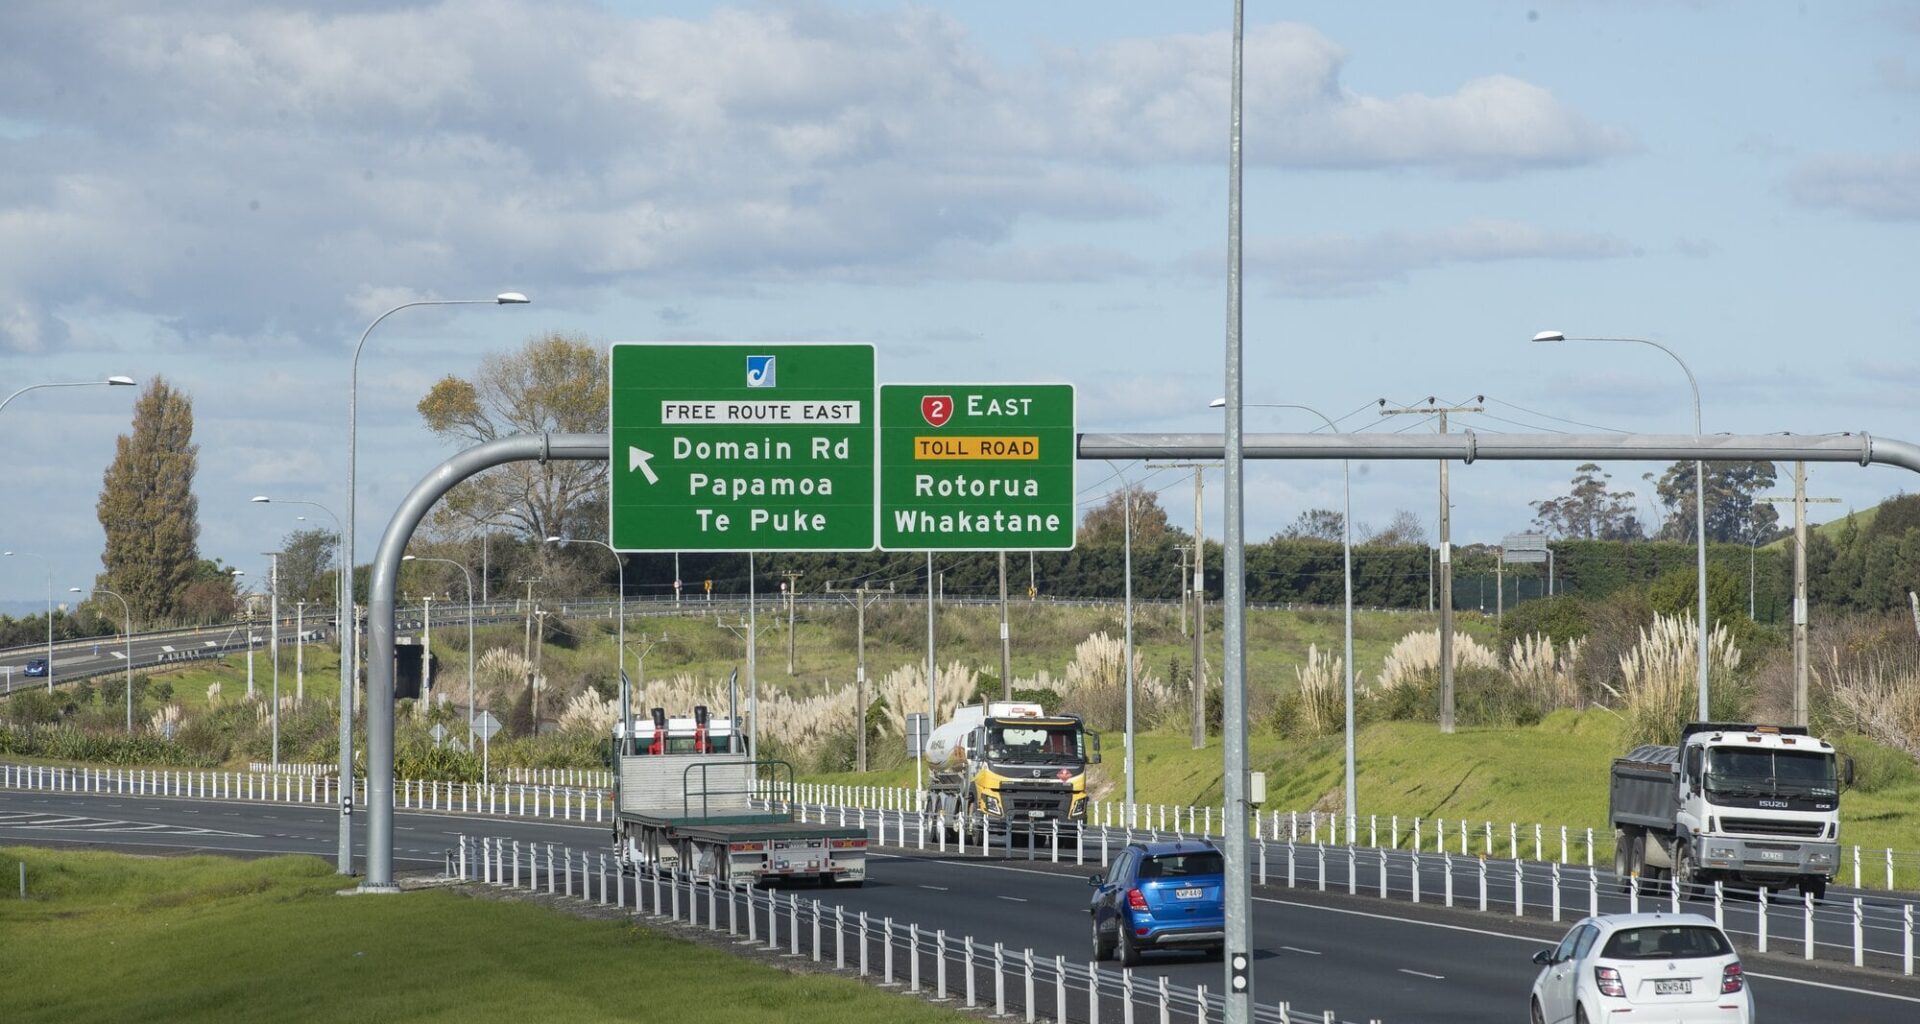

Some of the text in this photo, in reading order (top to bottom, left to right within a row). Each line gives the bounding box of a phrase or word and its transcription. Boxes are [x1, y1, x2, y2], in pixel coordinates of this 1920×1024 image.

[666, 405, 854, 419] FREE ROUTE EAST
[931, 395, 1033, 418] 2 EAST
[673, 436, 849, 460] Domain Rd
[920, 441, 1034, 456] TOLL ROAD
[689, 473, 832, 500] Papamoa
[915, 474, 1038, 497] Rotorua
[696, 509, 826, 532] Te Puke
[894, 510, 1060, 533] Whakatane
[1759, 800, 1789, 808] ISUZU
[1656, 983, 1690, 991] KRW541
